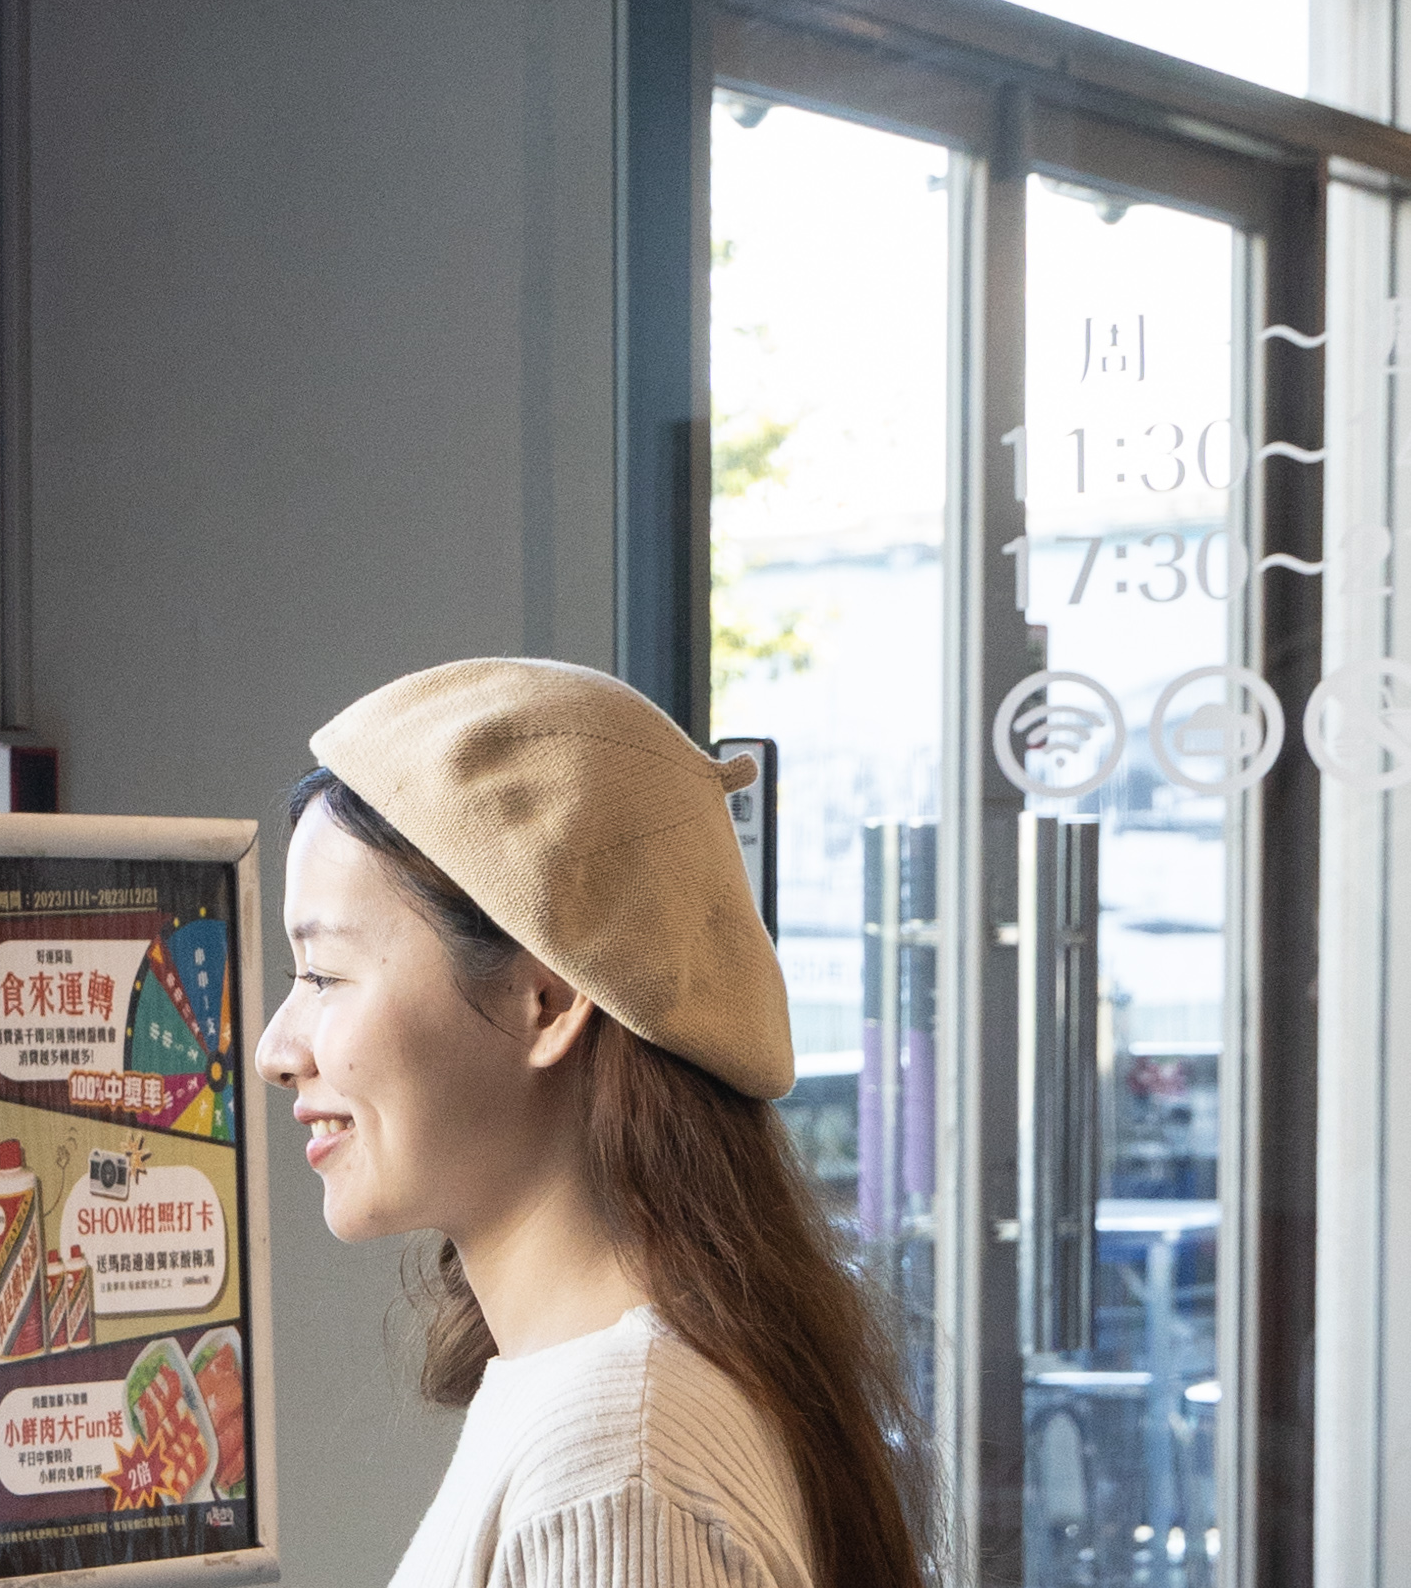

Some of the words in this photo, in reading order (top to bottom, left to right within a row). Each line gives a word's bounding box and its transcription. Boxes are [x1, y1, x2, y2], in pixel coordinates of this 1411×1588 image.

[0, 969, 116, 1022] 食來運轉
[69, 1072, 164, 1109] 100%中獎率
[77, 1200, 215, 1237] SHOW拍照打卡
[4, 1410, 124, 1448] 小鮮肉大Fun送
[127, 1460, 152, 1491] 2倍
